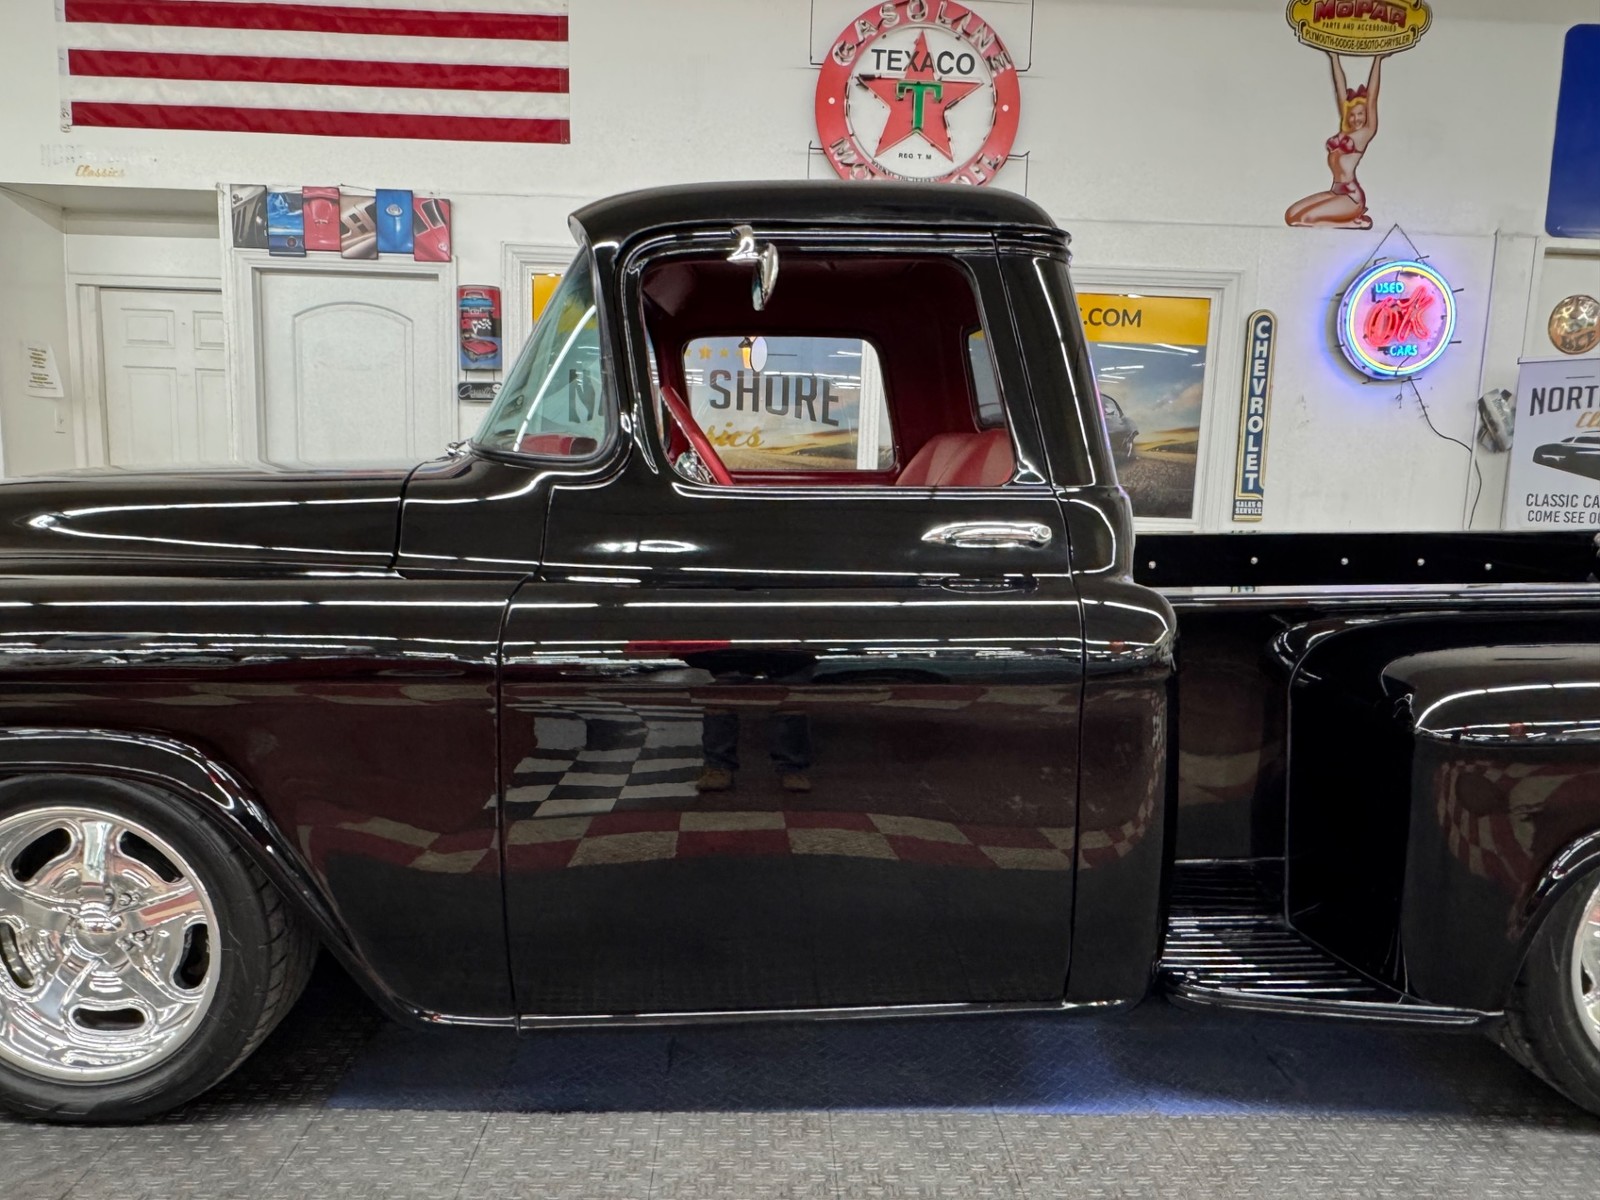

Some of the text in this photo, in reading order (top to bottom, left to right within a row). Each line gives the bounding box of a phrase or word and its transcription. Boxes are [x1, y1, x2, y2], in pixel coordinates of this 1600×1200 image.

[1342, 23, 1355, 31] AND
[871, 49, 976, 76] TEXACO
[896, 81, 943, 132] T
[1375, 282, 1405, 293] USED
[1080, 307, 1142, 328] .COM
[1389, 345, 1418, 356] CARS
[709, 369, 839, 427] SHORE
[1244, 320, 1271, 490] CHEVROLET
[1529, 385, 1600, 416] NORT
[1526, 493, 1579, 508] CLASSIC
[1527, 510, 1560, 523] COME
[1563, 511, 1585, 524] SEE
